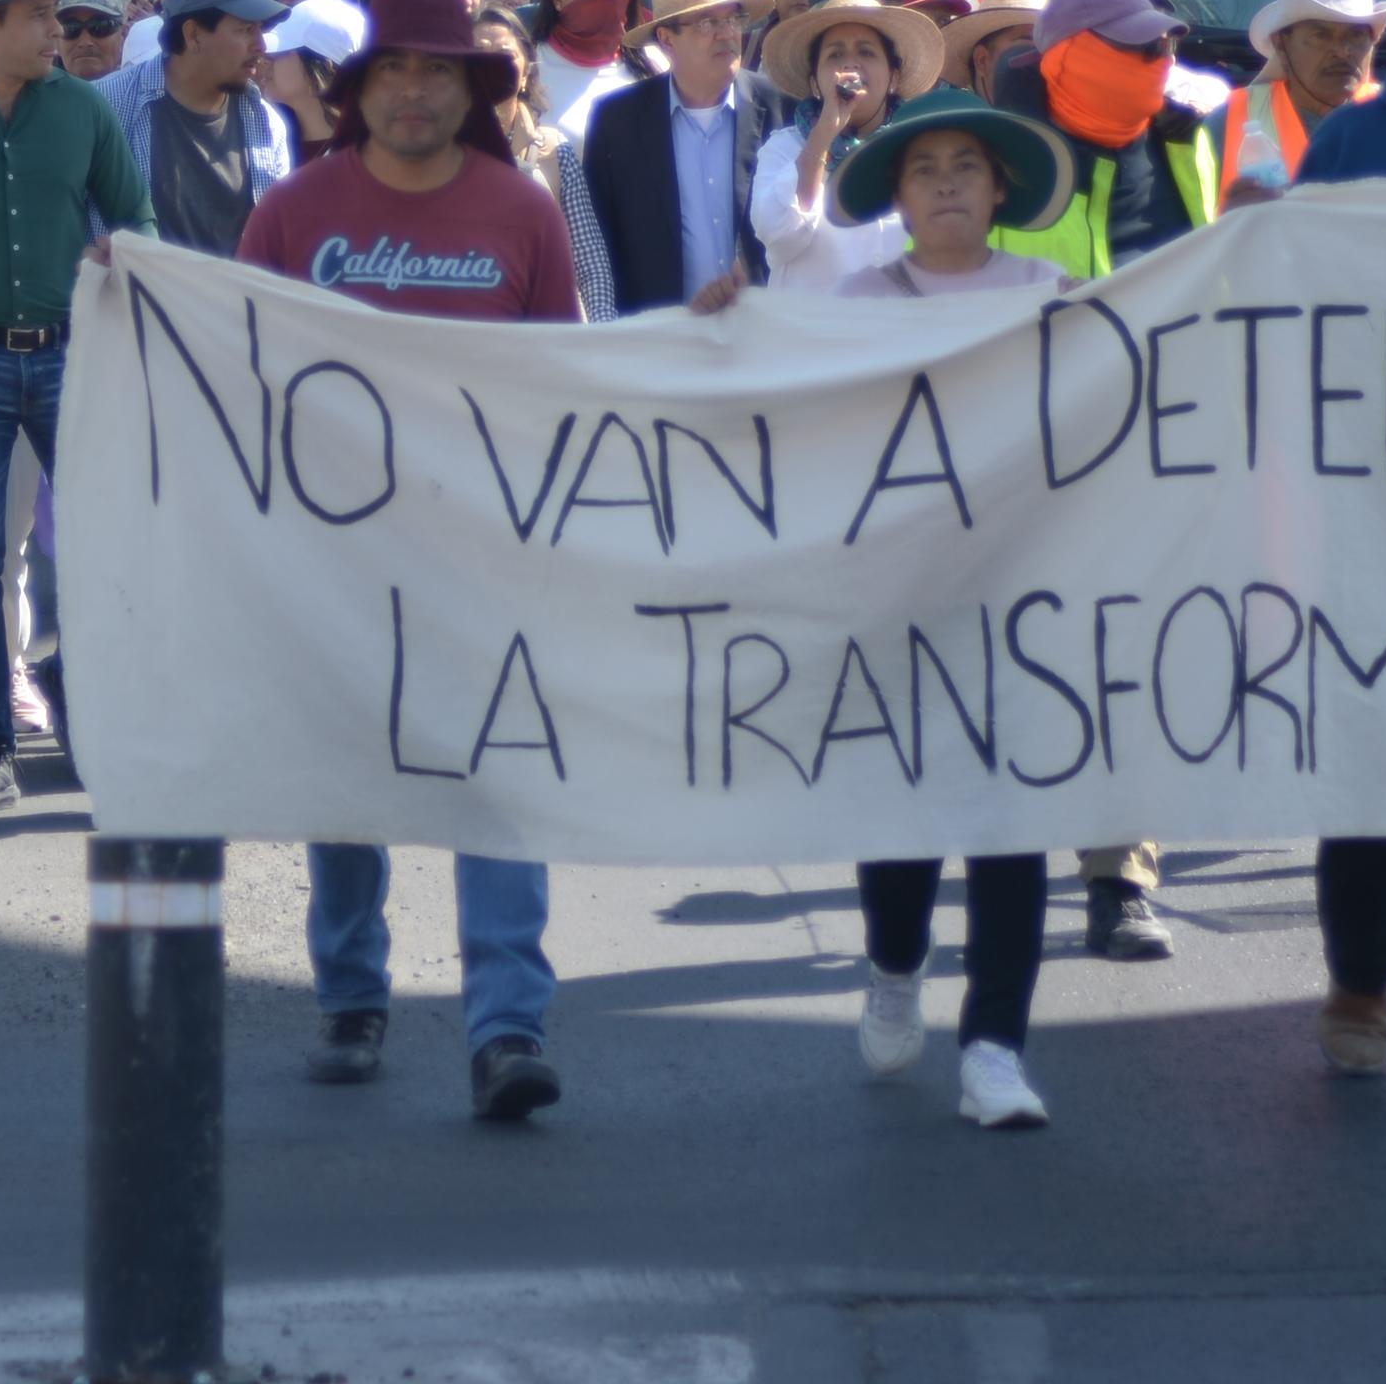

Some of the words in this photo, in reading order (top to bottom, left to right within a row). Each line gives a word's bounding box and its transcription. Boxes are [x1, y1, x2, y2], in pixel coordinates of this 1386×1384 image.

[312, 235, 502, 291] California
[127, 271, 397, 526] NO
[458, 385, 778, 556] VAN
[843, 370, 975, 547] A
[388, 585, 567, 782] LA
